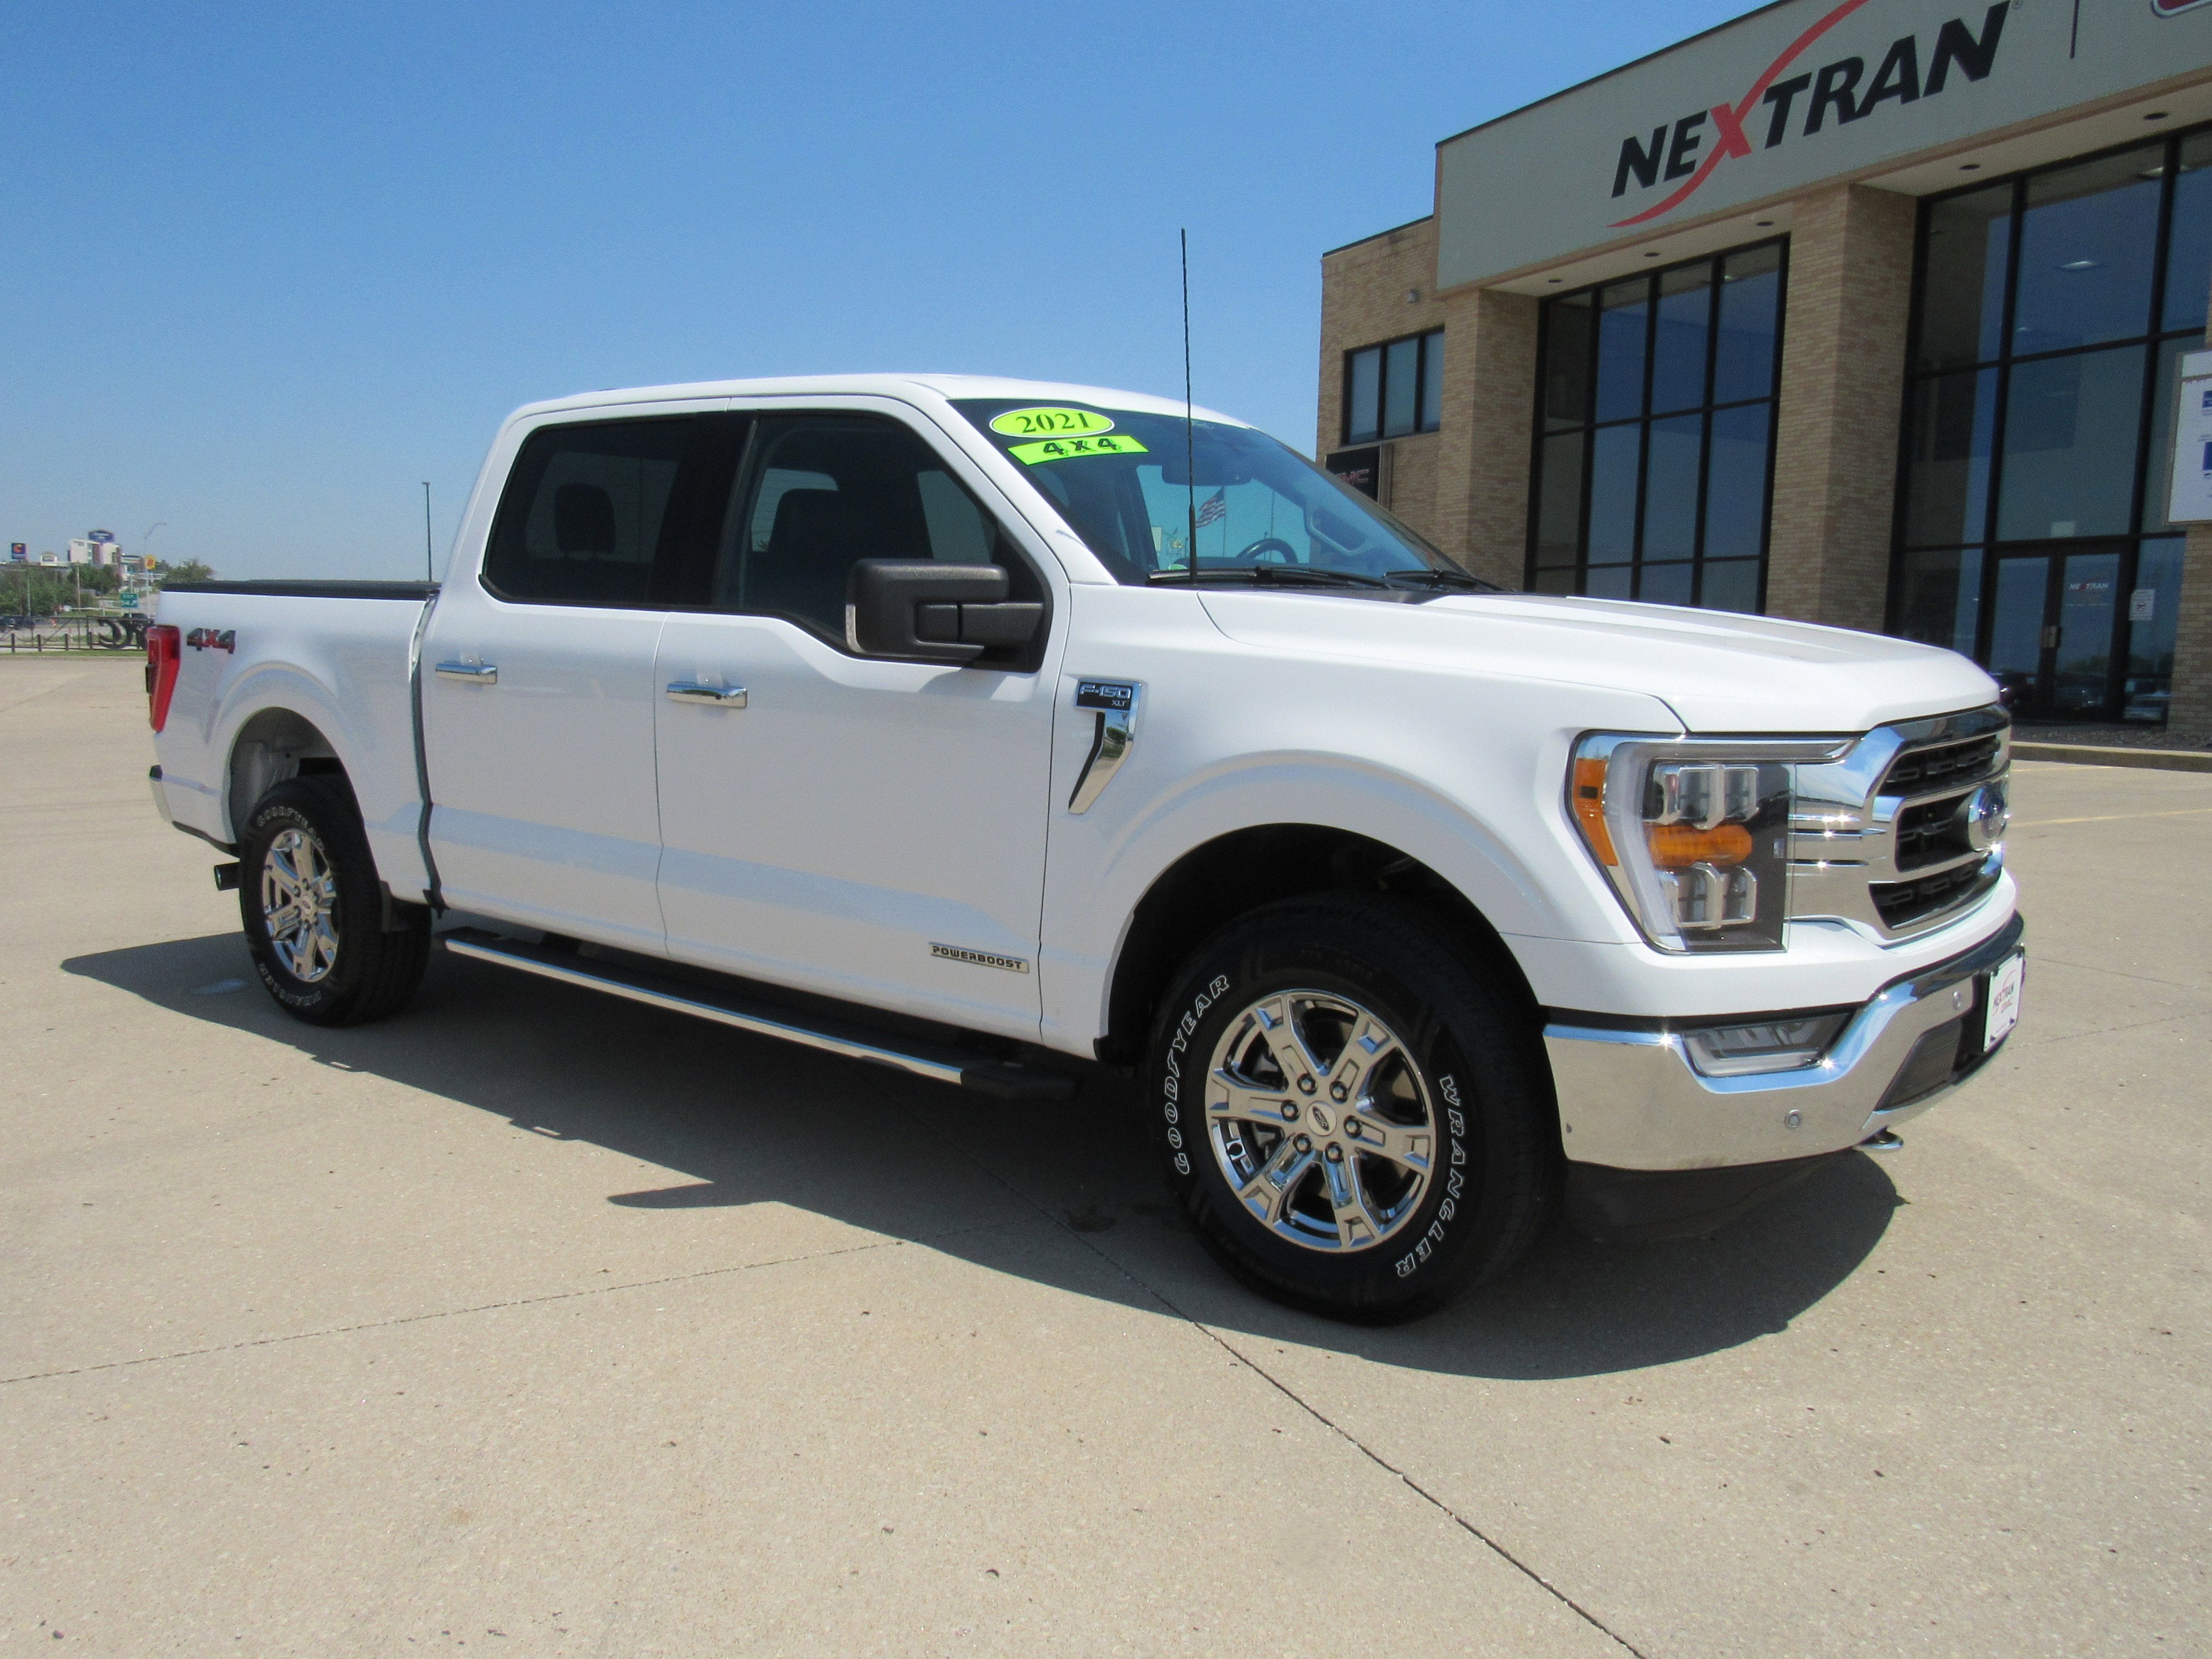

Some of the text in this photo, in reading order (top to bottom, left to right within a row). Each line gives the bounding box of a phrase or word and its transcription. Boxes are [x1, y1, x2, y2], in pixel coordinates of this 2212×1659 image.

[1611, 0, 2010, 199] NEXTRAN
[1016, 412, 1092, 433] 2021
[1080, 683, 1131, 699] F-150
[933, 946, 1022, 969] POWERBOOST
[1165, 975, 1230, 1174] GOODYEAR
[1396, 1075, 1464, 1277] WRANGLER
